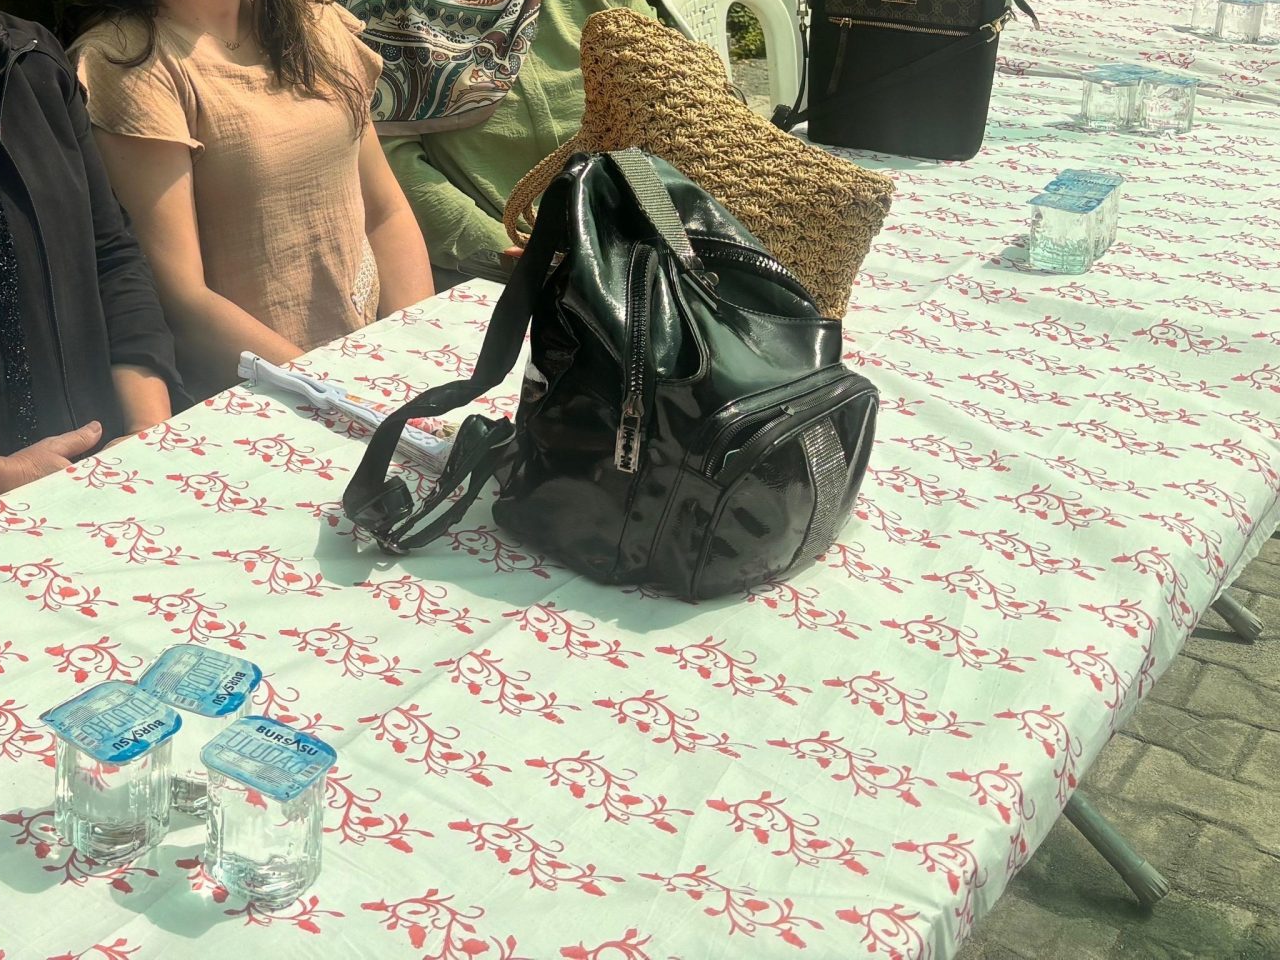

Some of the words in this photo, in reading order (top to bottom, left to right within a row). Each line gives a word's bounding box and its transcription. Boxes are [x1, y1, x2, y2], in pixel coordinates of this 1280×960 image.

[212, 671, 247, 705] BURSASU
[112, 719, 165, 751] BURSASU
[255, 725, 319, 756] BURSASU
